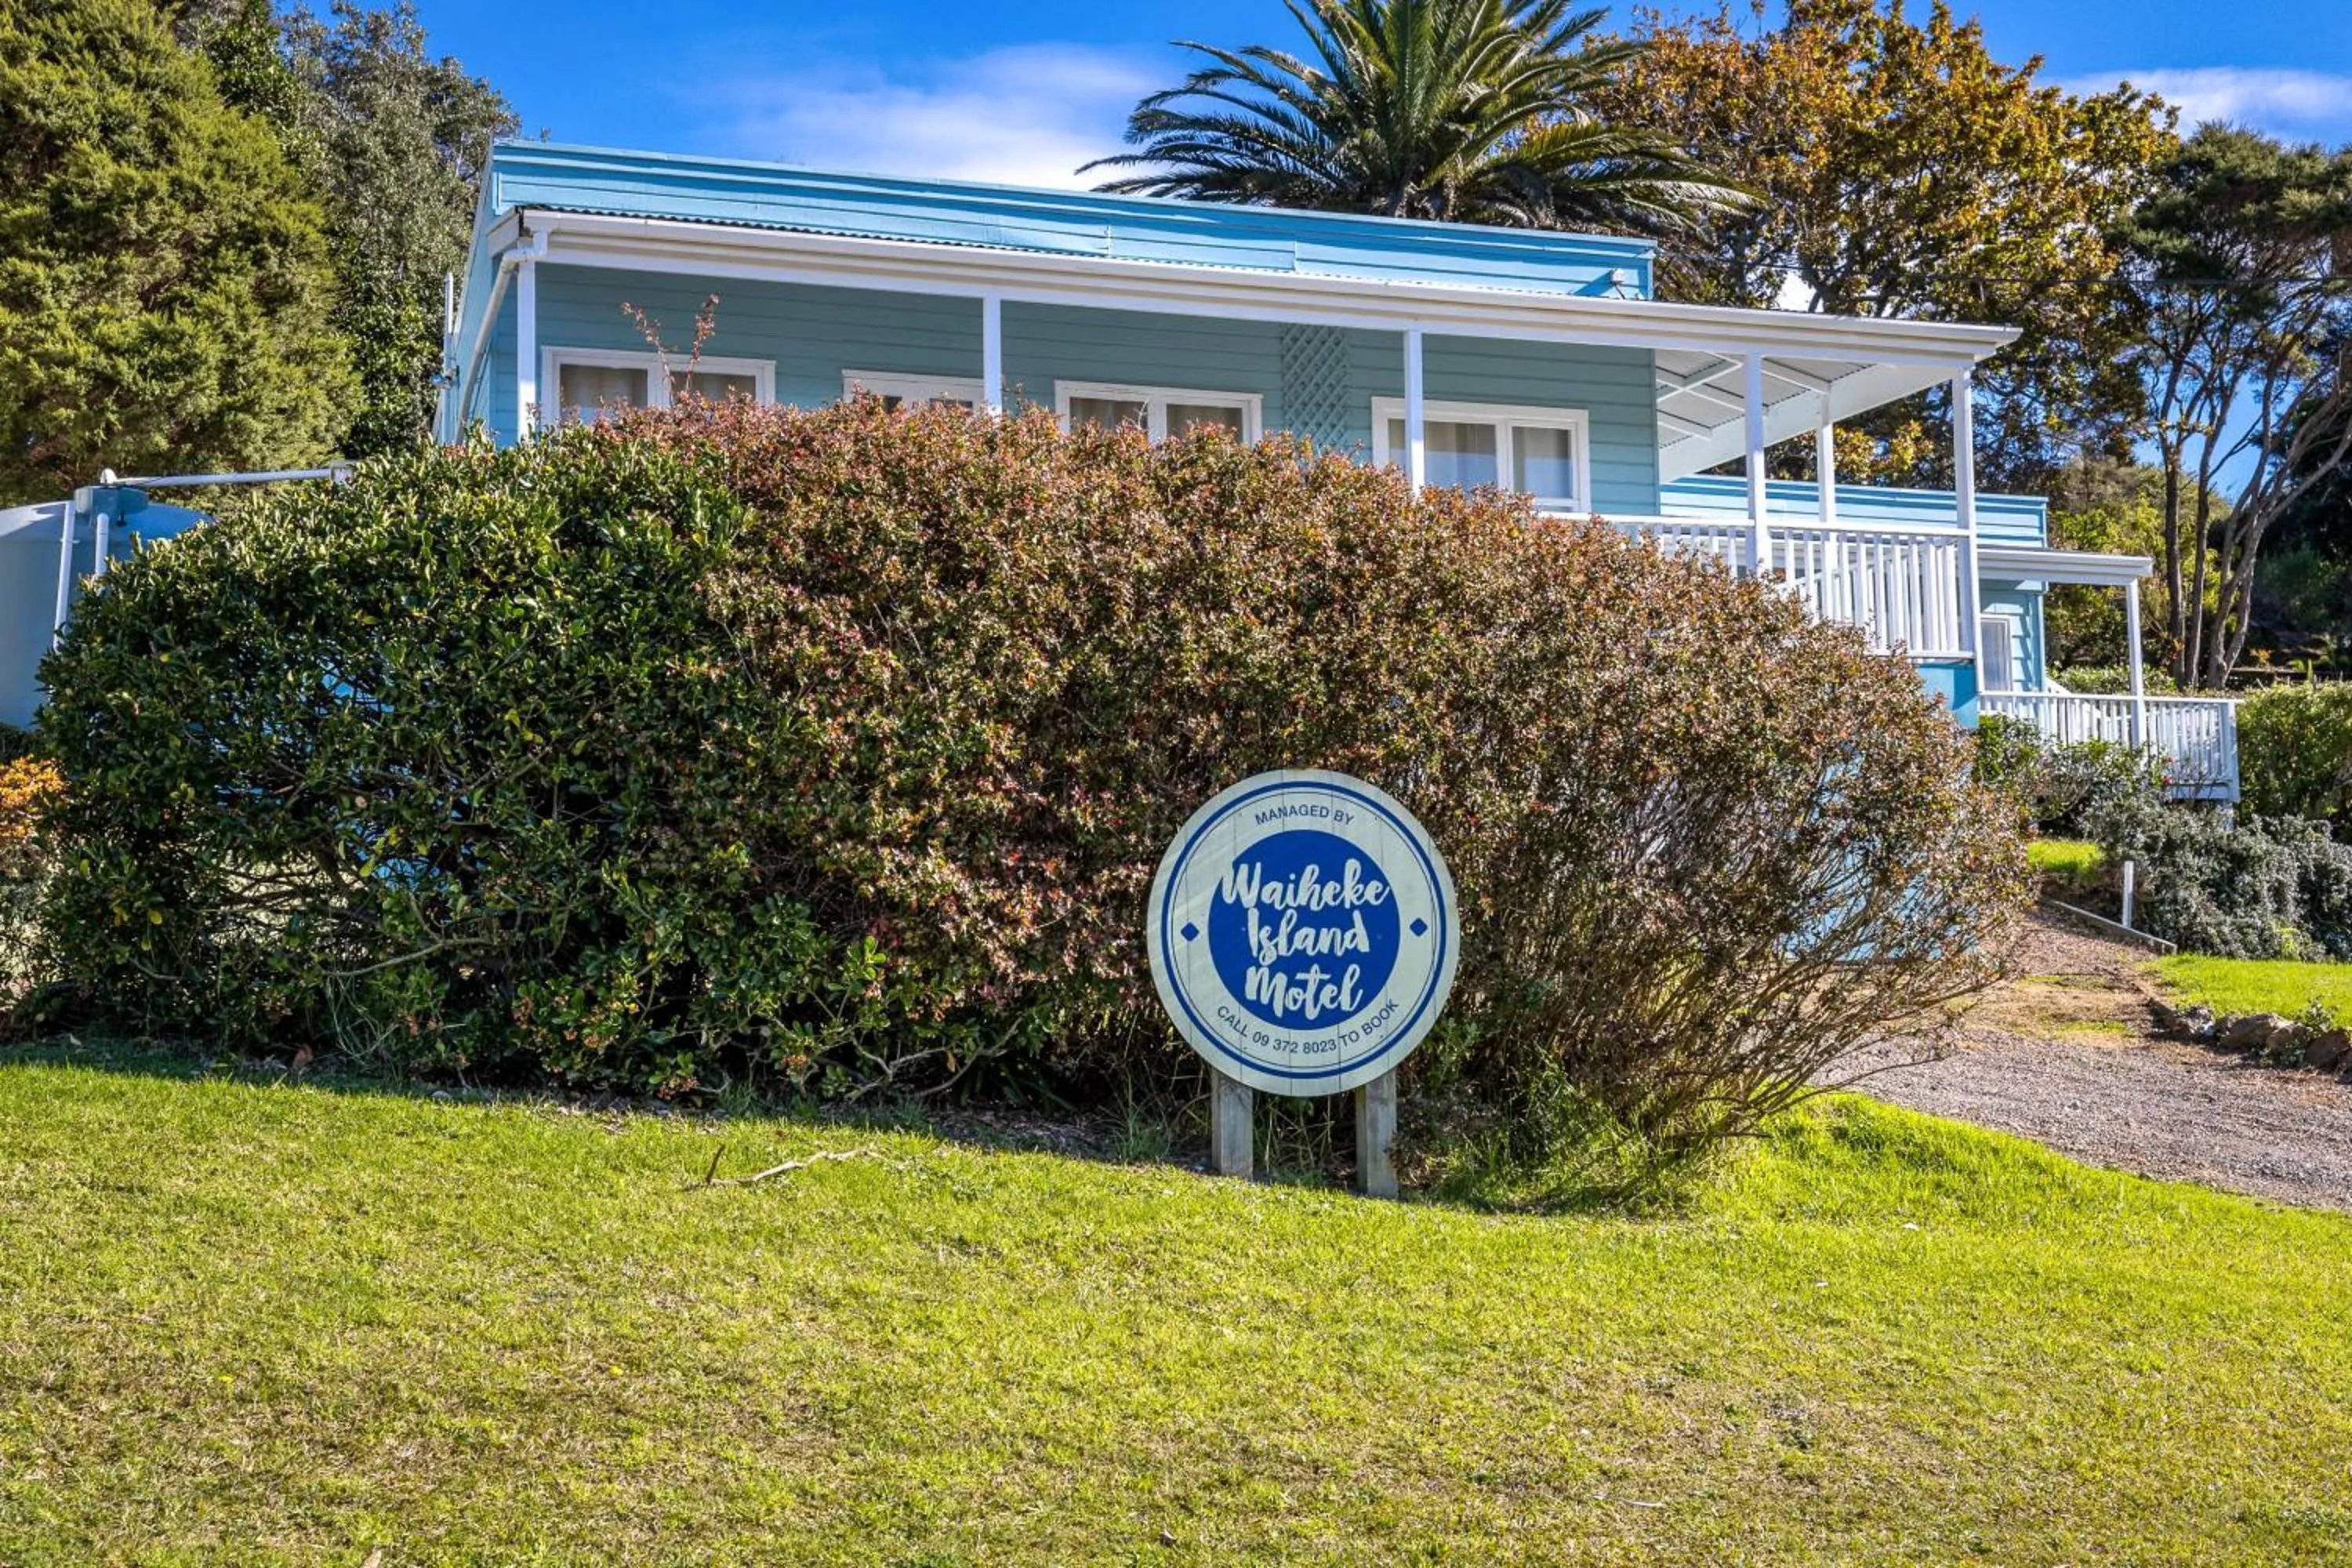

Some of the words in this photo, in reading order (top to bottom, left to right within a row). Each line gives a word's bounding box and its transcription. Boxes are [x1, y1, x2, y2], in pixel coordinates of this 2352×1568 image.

[1254, 804, 1330, 826] MANAGED
[1333, 809, 1356, 826] BY
[1221, 858, 1390, 912] Waiheke
[1247, 909, 1370, 967] Island
[1245, 964, 1363, 1021] Motel
[1217, 1005, 1249, 1038] CALL
[1252, 1031, 1269, 1047] 09
[1273, 1037, 1298, 1054] 372
[1302, 1039, 1337, 1054] 8023
[1340, 1031, 1359, 1047] TO
[1363, 999, 1399, 1036] BOOK
